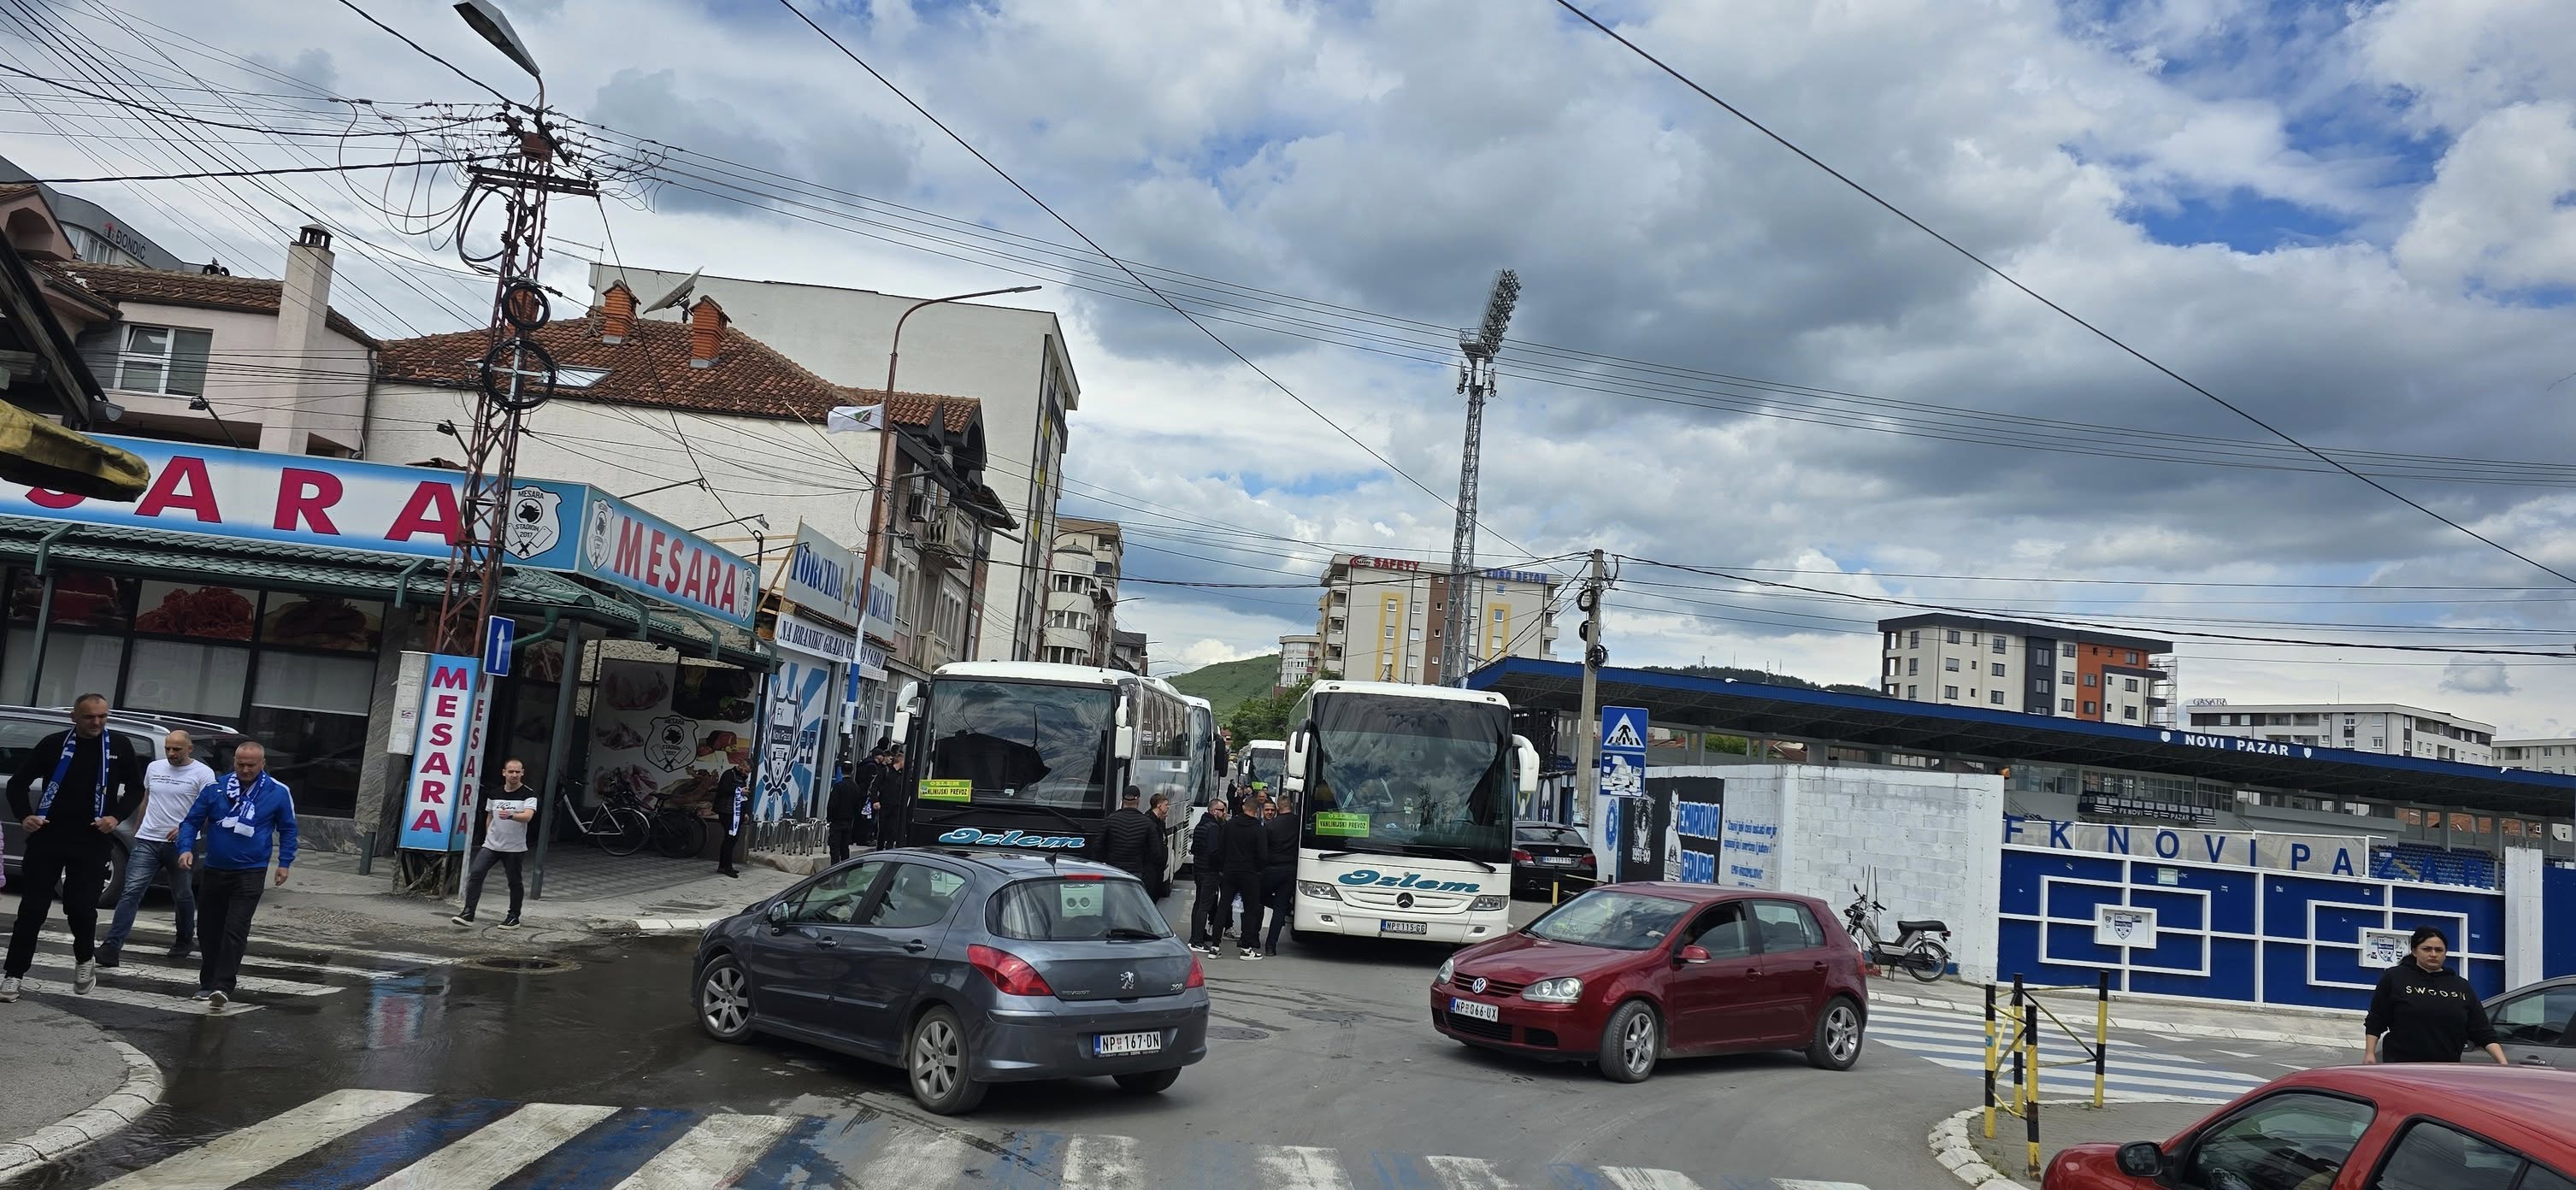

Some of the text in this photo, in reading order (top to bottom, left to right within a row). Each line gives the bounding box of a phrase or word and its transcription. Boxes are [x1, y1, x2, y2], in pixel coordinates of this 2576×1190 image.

[517, 490, 545, 500] MESARA
[613, 515, 736, 615] MESARA
[1374, 557, 1420, 572] SAFETY
[791, 544, 895, 626] TORCIDA SNDŽAK
[779, 621, 793, 642] NA
[410, 665, 469, 834] MESARA
[2184, 733, 2290, 757] NOVI PAZAR
[1678, 801, 1720, 841] EMIROVA
[2128, 808, 2143, 816] NOVI
[2170, 813, 2190, 822] PAZAR
[938, 828, 1086, 848] Ozlem
[2004, 816, 2074, 850] FK
[2107, 825, 2256, 868] NOVI
[1338, 869, 1481, 893] Ozlem
[1386, 922, 1396, 930] NP
[2405, 985, 2467, 1001] SWOOSH
[1455, 1000, 1465, 1013] NP
[1102, 1036, 1116, 1052] NP
